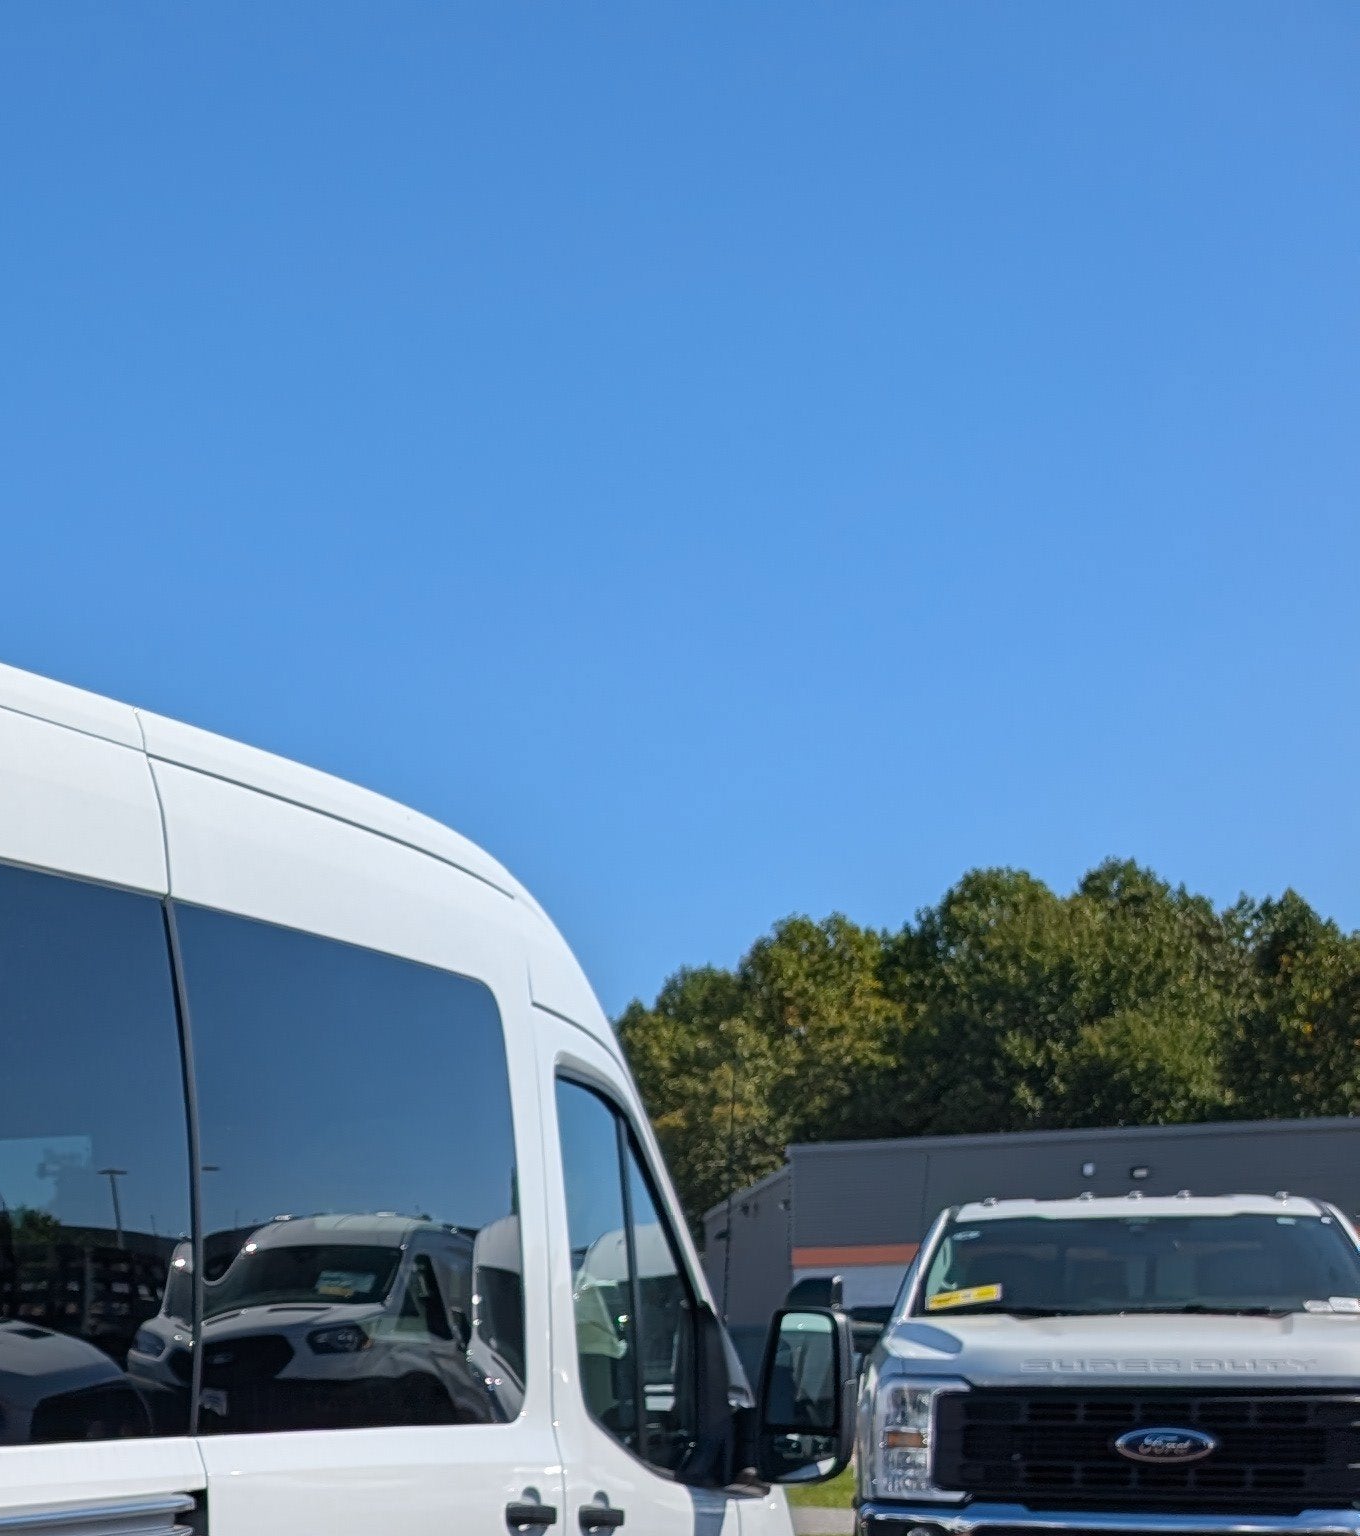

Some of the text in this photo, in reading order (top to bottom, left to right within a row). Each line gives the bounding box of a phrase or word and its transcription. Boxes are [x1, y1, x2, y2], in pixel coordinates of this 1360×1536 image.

[1019, 1358, 1318, 1374] SUPER DUTY
[1138, 1434, 1192, 1455] Ford
